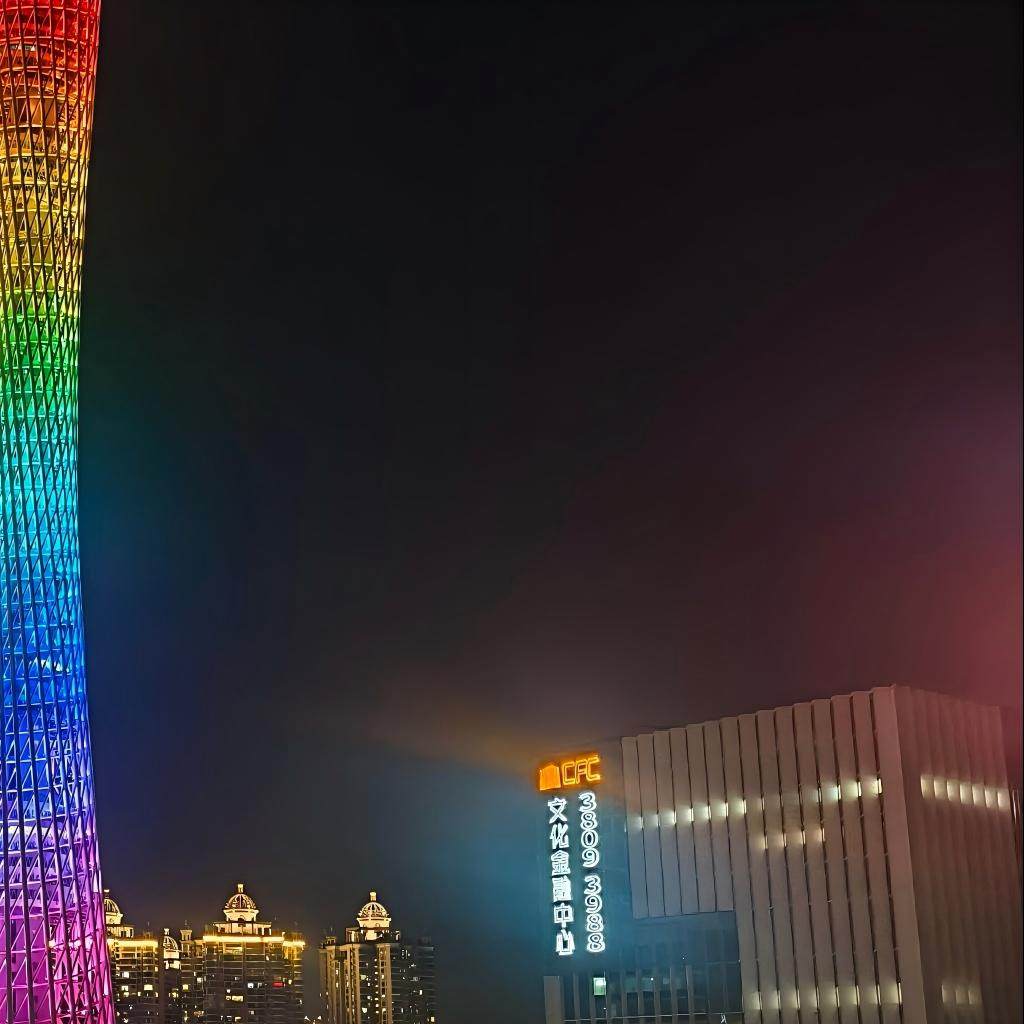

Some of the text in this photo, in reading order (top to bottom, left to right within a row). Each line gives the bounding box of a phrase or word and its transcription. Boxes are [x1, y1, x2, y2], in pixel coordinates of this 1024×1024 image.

[561, 755, 601, 786] CFC
[579, 791, 606, 953] 3809 3988
